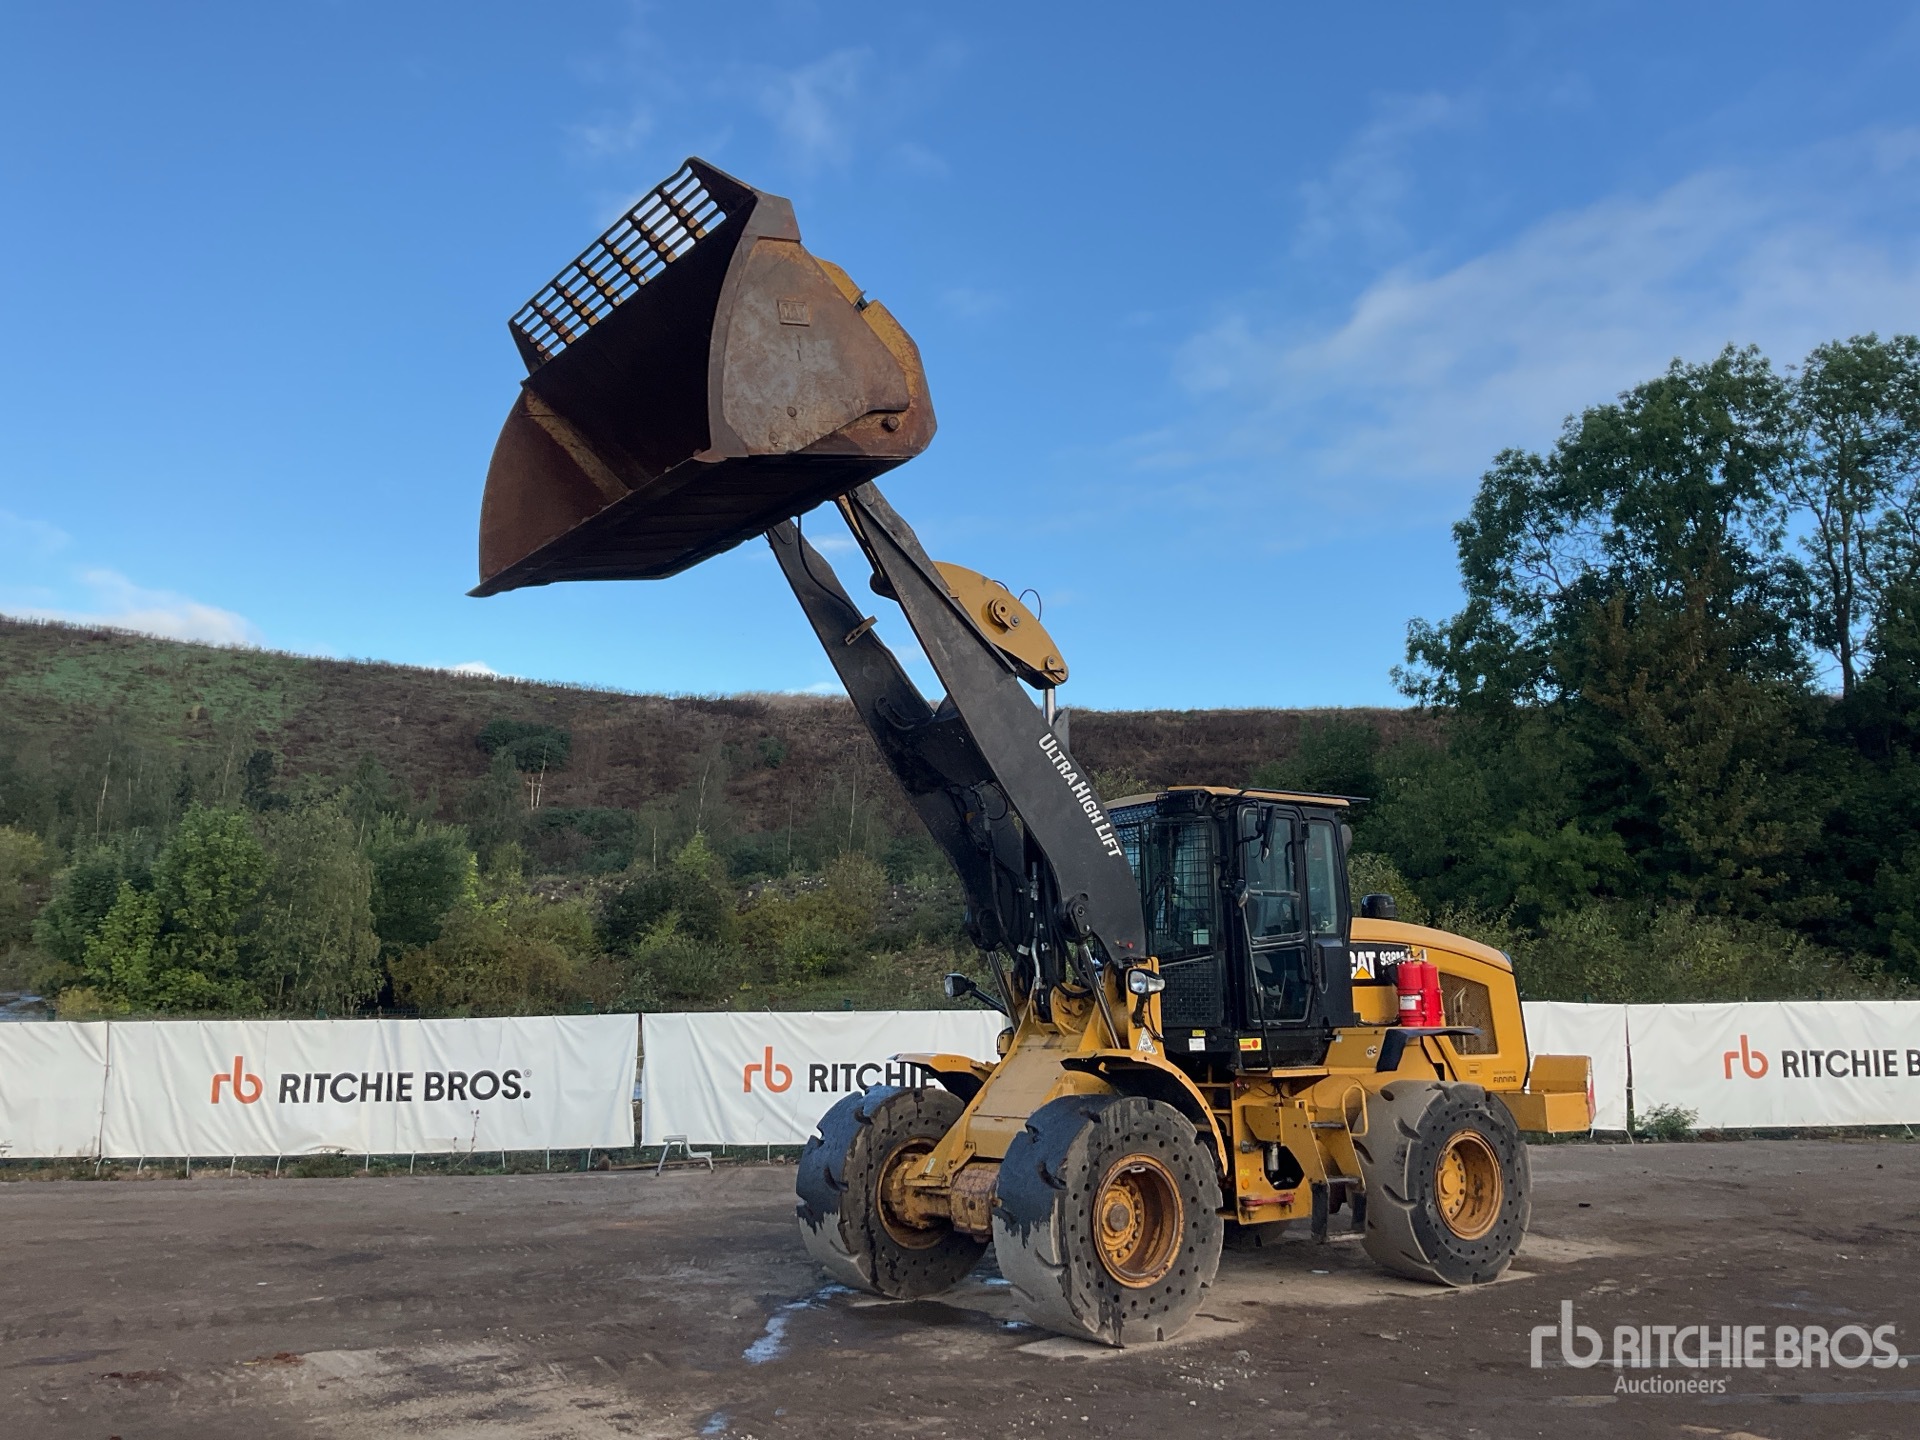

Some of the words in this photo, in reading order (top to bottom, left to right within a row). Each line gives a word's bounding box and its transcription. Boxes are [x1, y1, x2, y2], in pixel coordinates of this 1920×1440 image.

[1038, 733, 1078, 786] ULTRA
[1071, 781, 1104, 824] HIGH
[1095, 822, 1122, 856] LIFT
[1781, 1050, 1899, 1078] RITCHIE
[278, 1071, 414, 1104] RITCHIE
